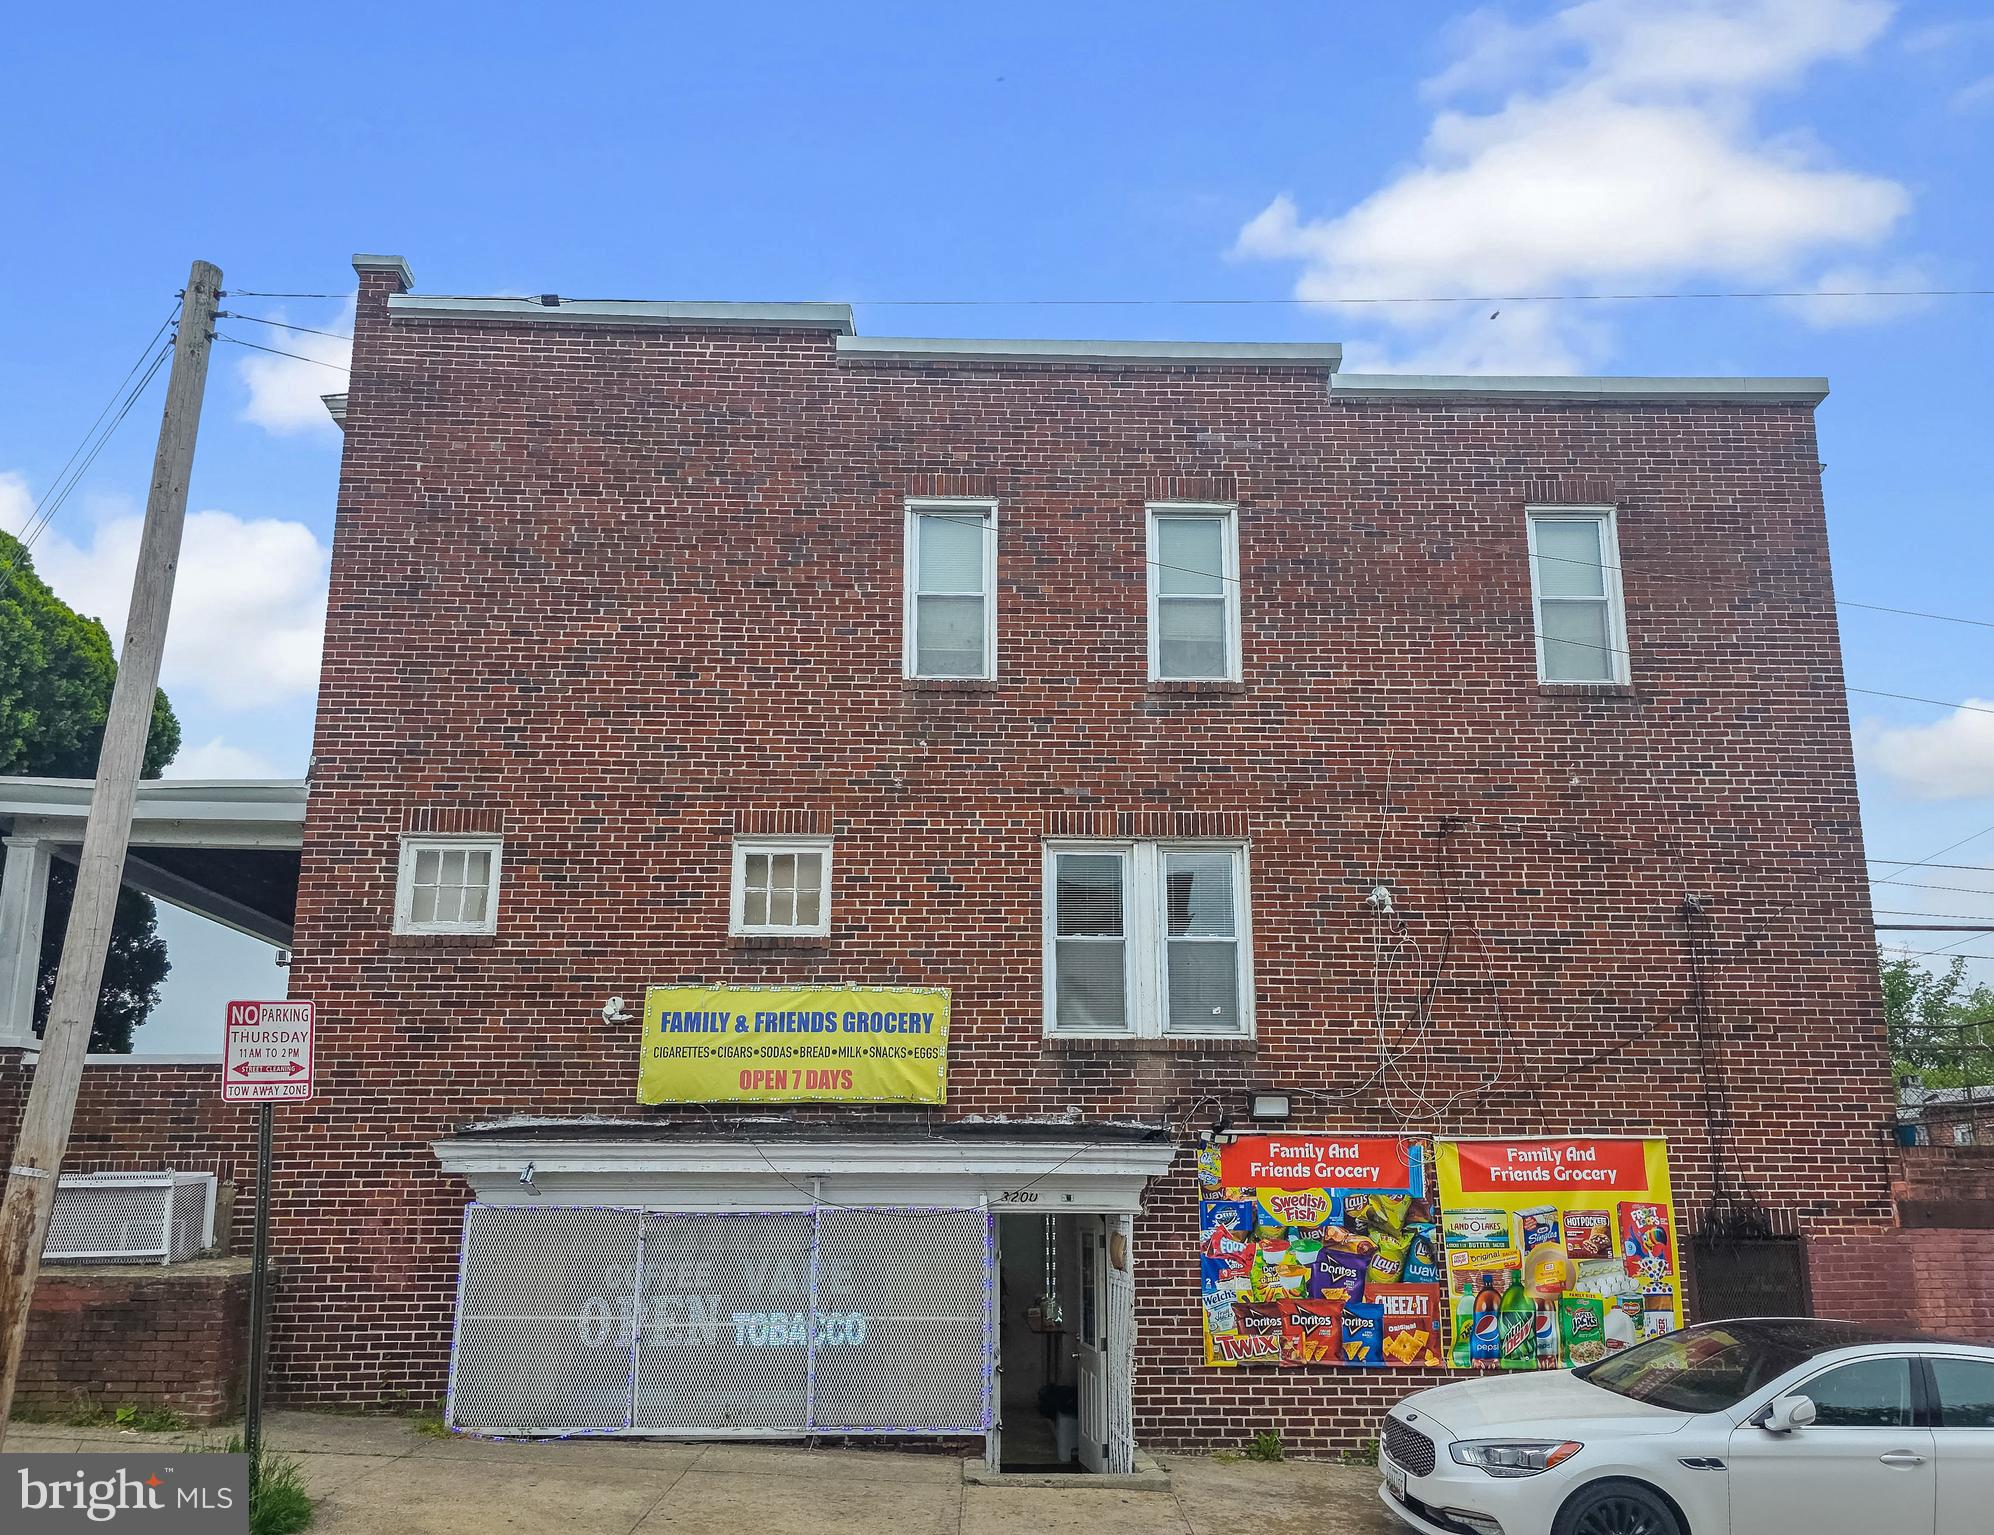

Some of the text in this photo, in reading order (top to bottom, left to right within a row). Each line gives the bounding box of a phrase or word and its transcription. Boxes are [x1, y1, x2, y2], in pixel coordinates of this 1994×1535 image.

[231, 1005, 309, 1025] NO PARKING
[660, 1011, 934, 1034] FAMILY & FRIENDS GROCERY
[231, 1031, 309, 1043] THURSDAY
[266, 1048, 278, 1058] TO
[241, 1065, 264, 1073] STREET
[739, 1069, 853, 1090] OPEN 7 DAYS
[228, 1085, 307, 1096] TOW AWAY ZONE
[1269, 1143, 1359, 1162] Family And
[1507, 1146, 1596, 1165] Family And
[1250, 1162, 1380, 1182] Friends Grocery
[1490, 1166, 1617, 1184] Friends Grocery
[1203, 1188, 1224, 1199] wav
[1270, 1193, 1328, 1213] Swedish
[1284, 1207, 1317, 1222] Fish
[1300, 1226, 1326, 1240] wav
[1528, 1231, 1558, 1244] Singles
[1372, 1255, 1399, 1273] Lay's
[1470, 1250, 1501, 1262] Original
[1320, 1262, 1357, 1278] Doritos
[1409, 1264, 1441, 1281] wavy
[1203, 1290, 1237, 1306] Welch's
[1245, 1317, 1282, 1328] Doritos
[1291, 1315, 1332, 1326] Doritos
[1658, 1318, 1666, 1336] DER
[1214, 1334, 1280, 1361] TWIX
[1476, 1343, 1499, 1352] pepsi
